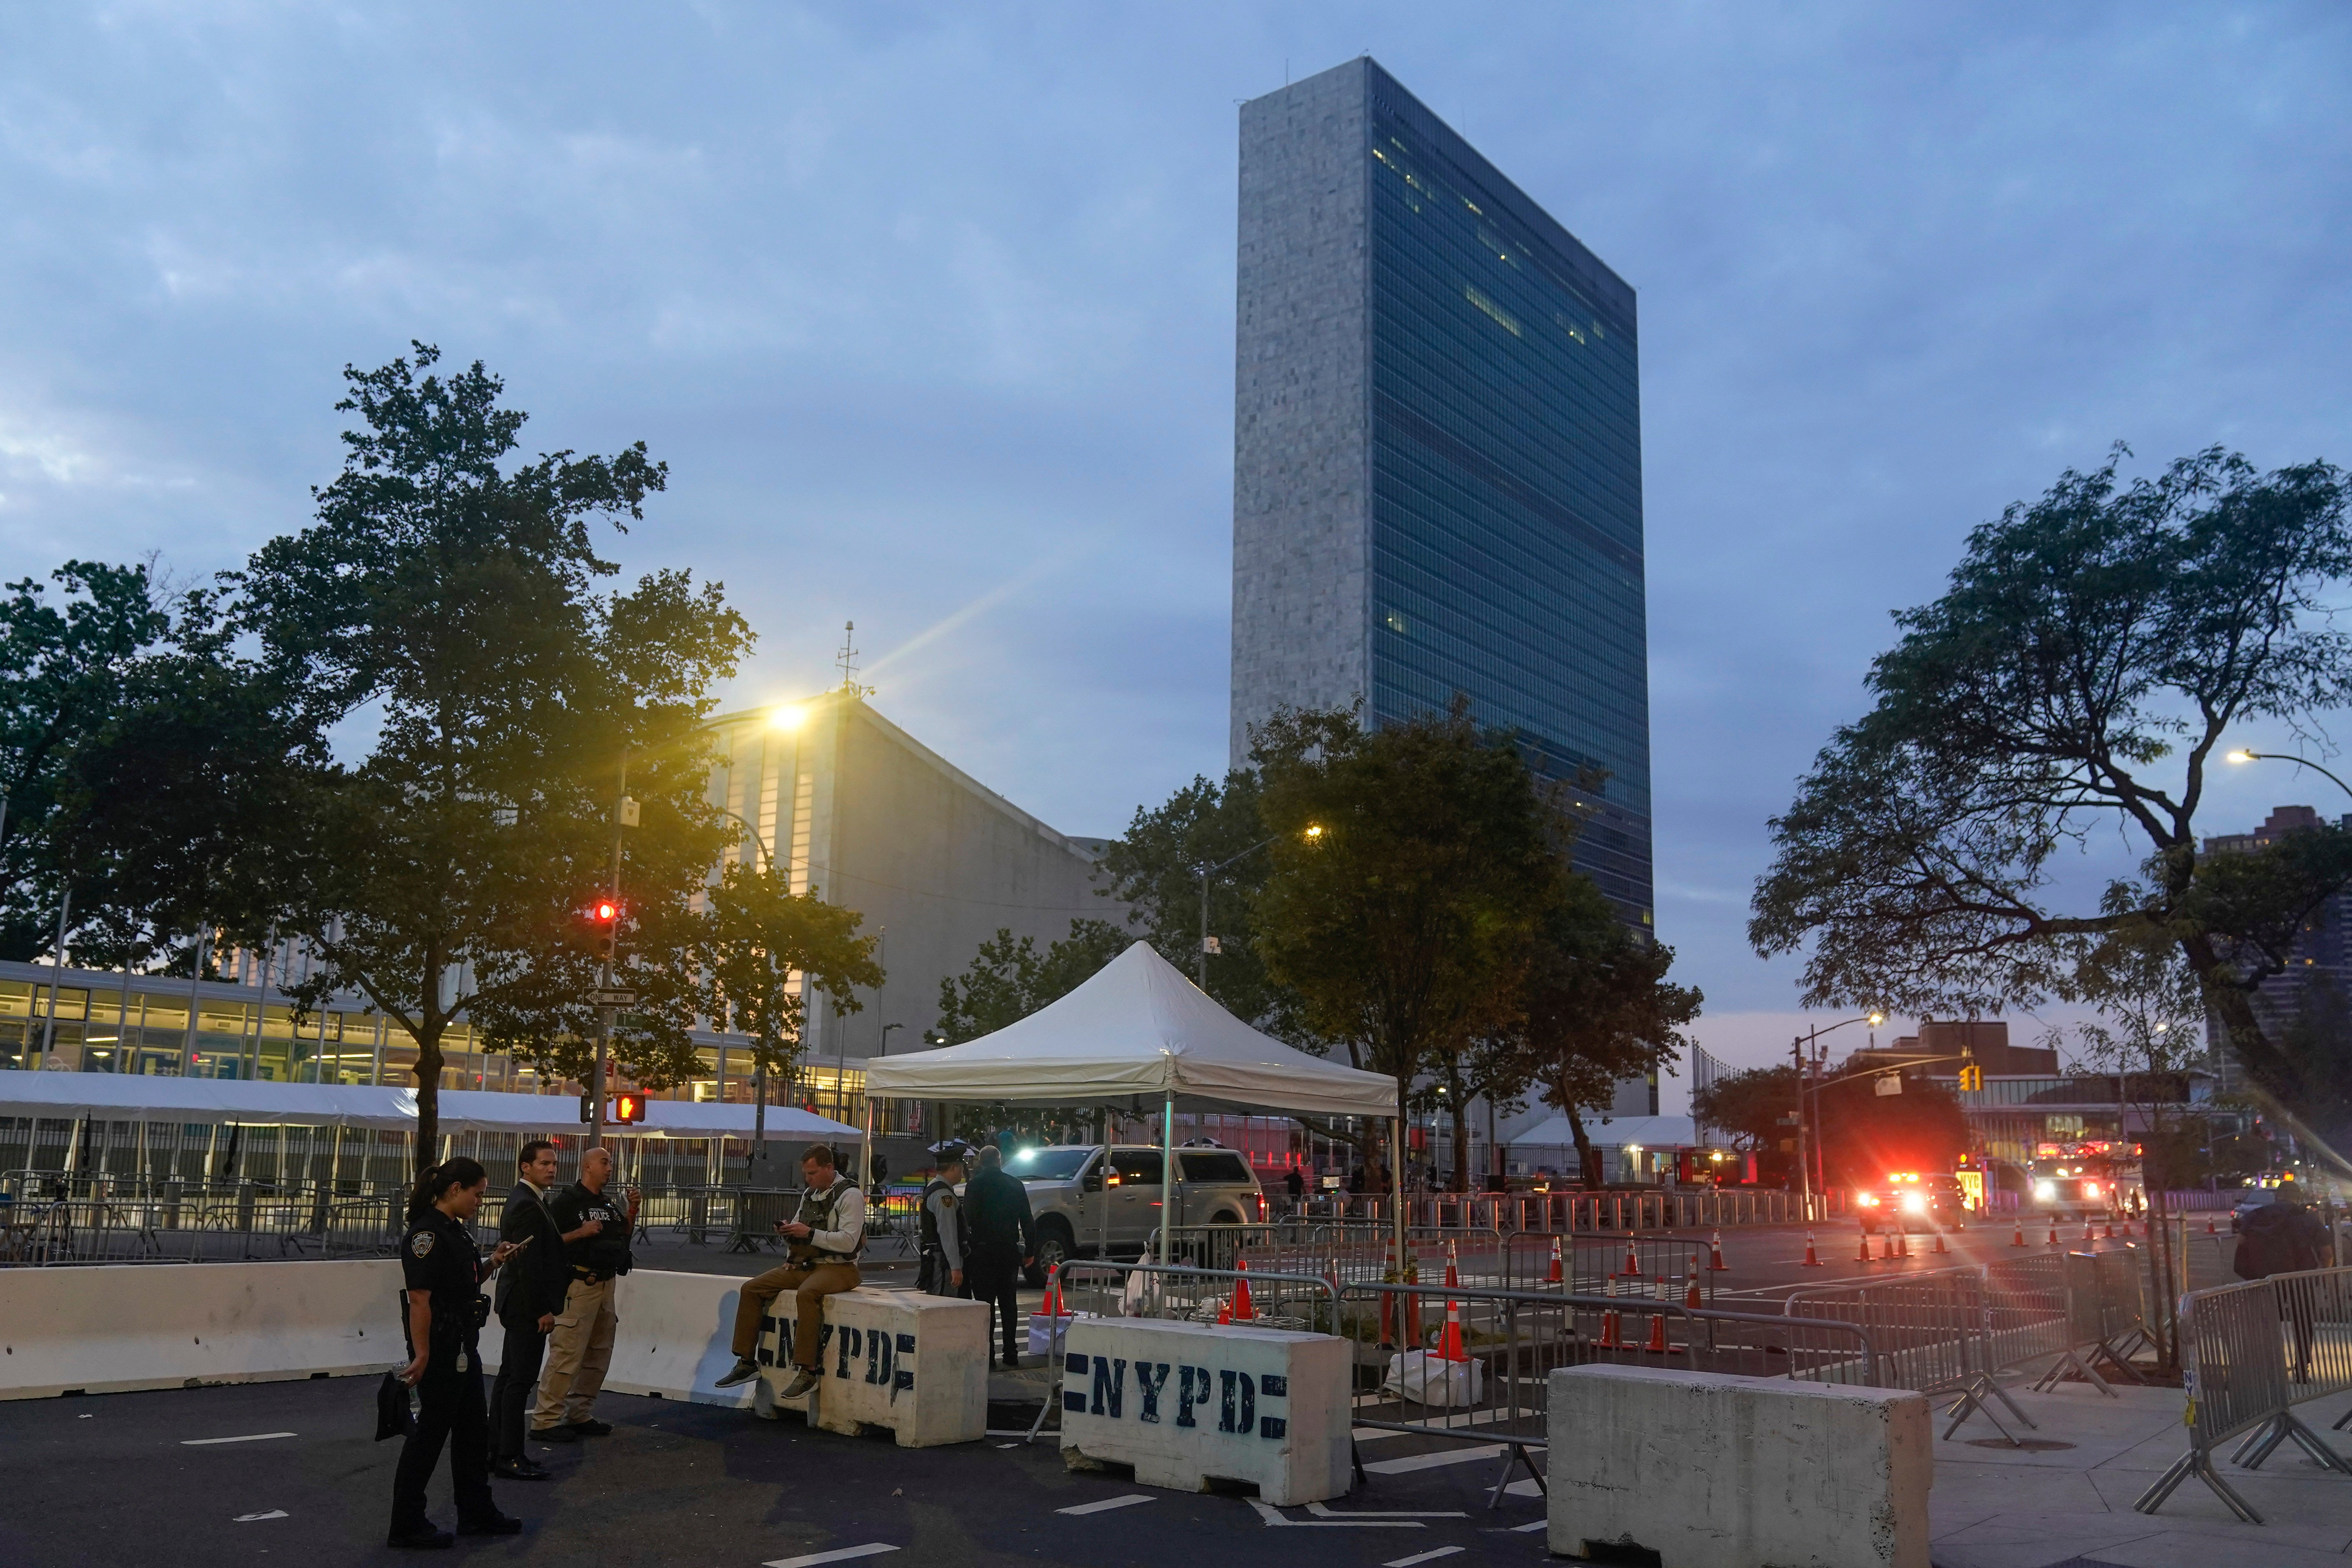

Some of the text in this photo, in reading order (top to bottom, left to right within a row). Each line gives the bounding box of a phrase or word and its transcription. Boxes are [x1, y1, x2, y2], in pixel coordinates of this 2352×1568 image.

[623, 1015, 626, 1026] 1
[1960, 1174, 1979, 1189] NYC
[589, 1211, 611, 1221] POLICE
[1091, 1356, 1255, 1434] NYPD
